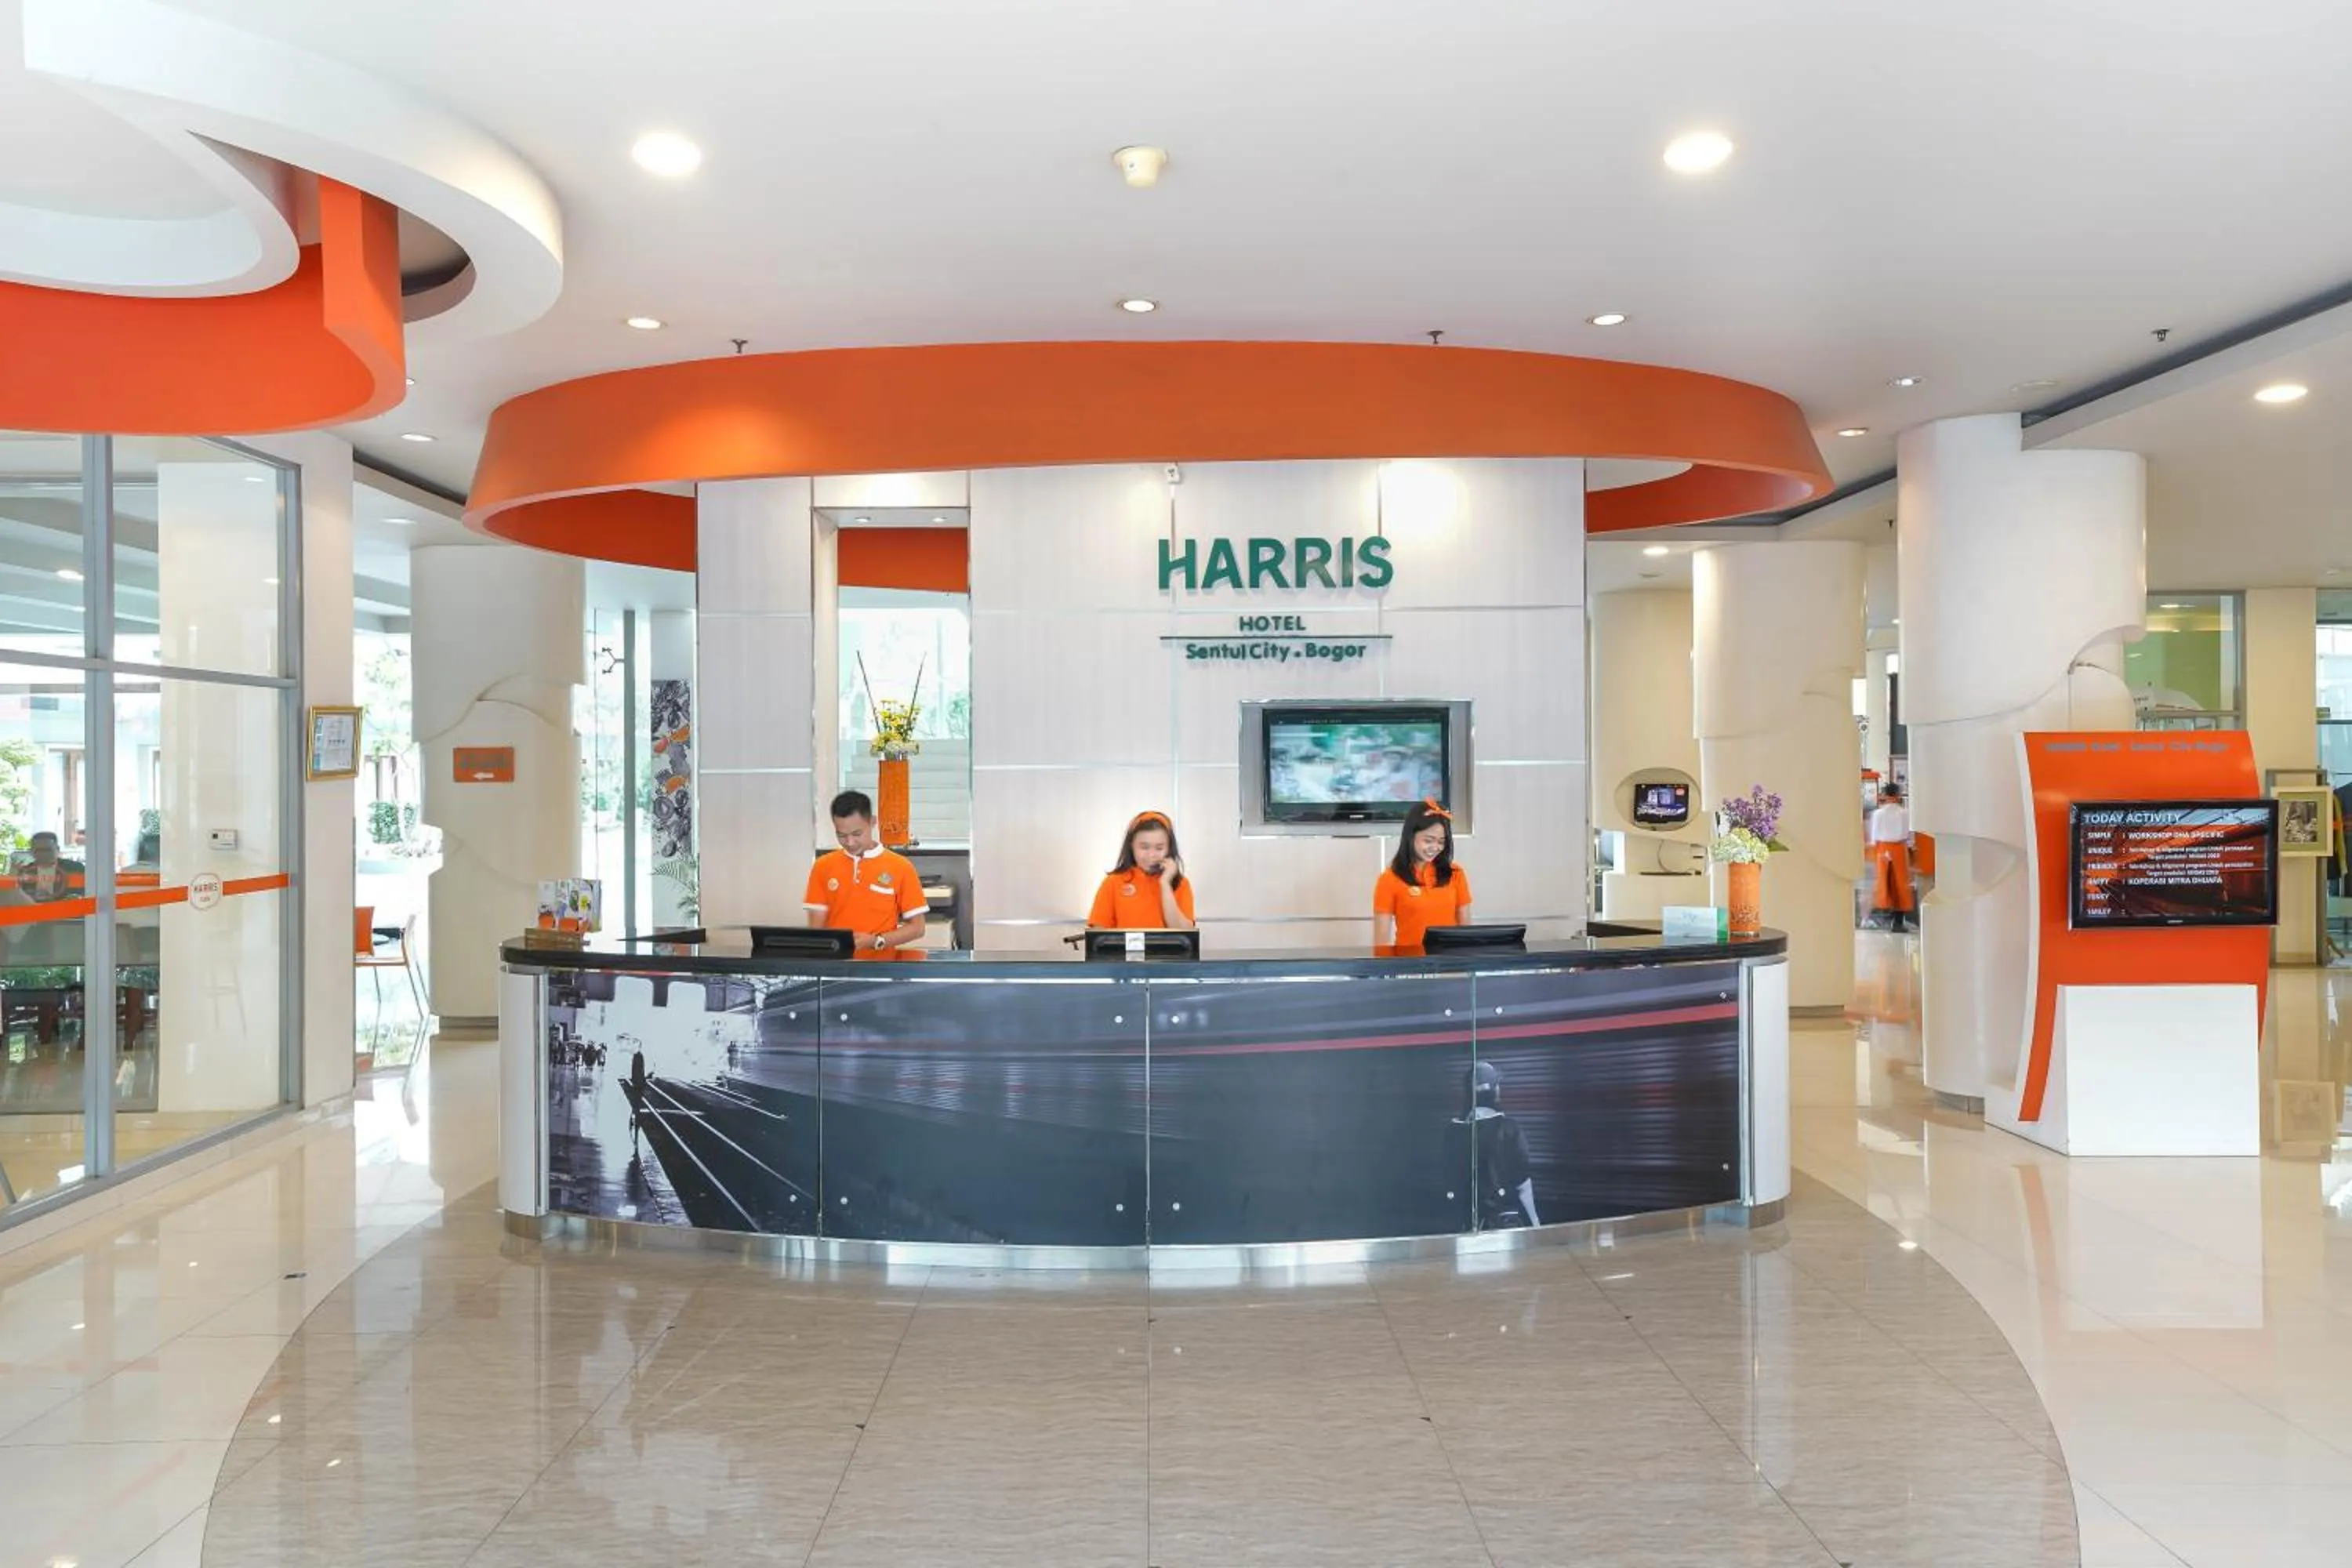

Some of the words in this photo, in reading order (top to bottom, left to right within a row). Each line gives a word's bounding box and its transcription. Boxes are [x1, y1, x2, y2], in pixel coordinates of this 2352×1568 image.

[1158, 535, 1393, 590] HARRIS
[1239, 615, 1307, 631] HOTEL
[1185, 643, 1245, 660] Sentul
[1305, 642, 1367, 662] Bogor
[2084, 812, 2124, 824] TODAY
[2125, 812, 2181, 823] ACTIVITY
